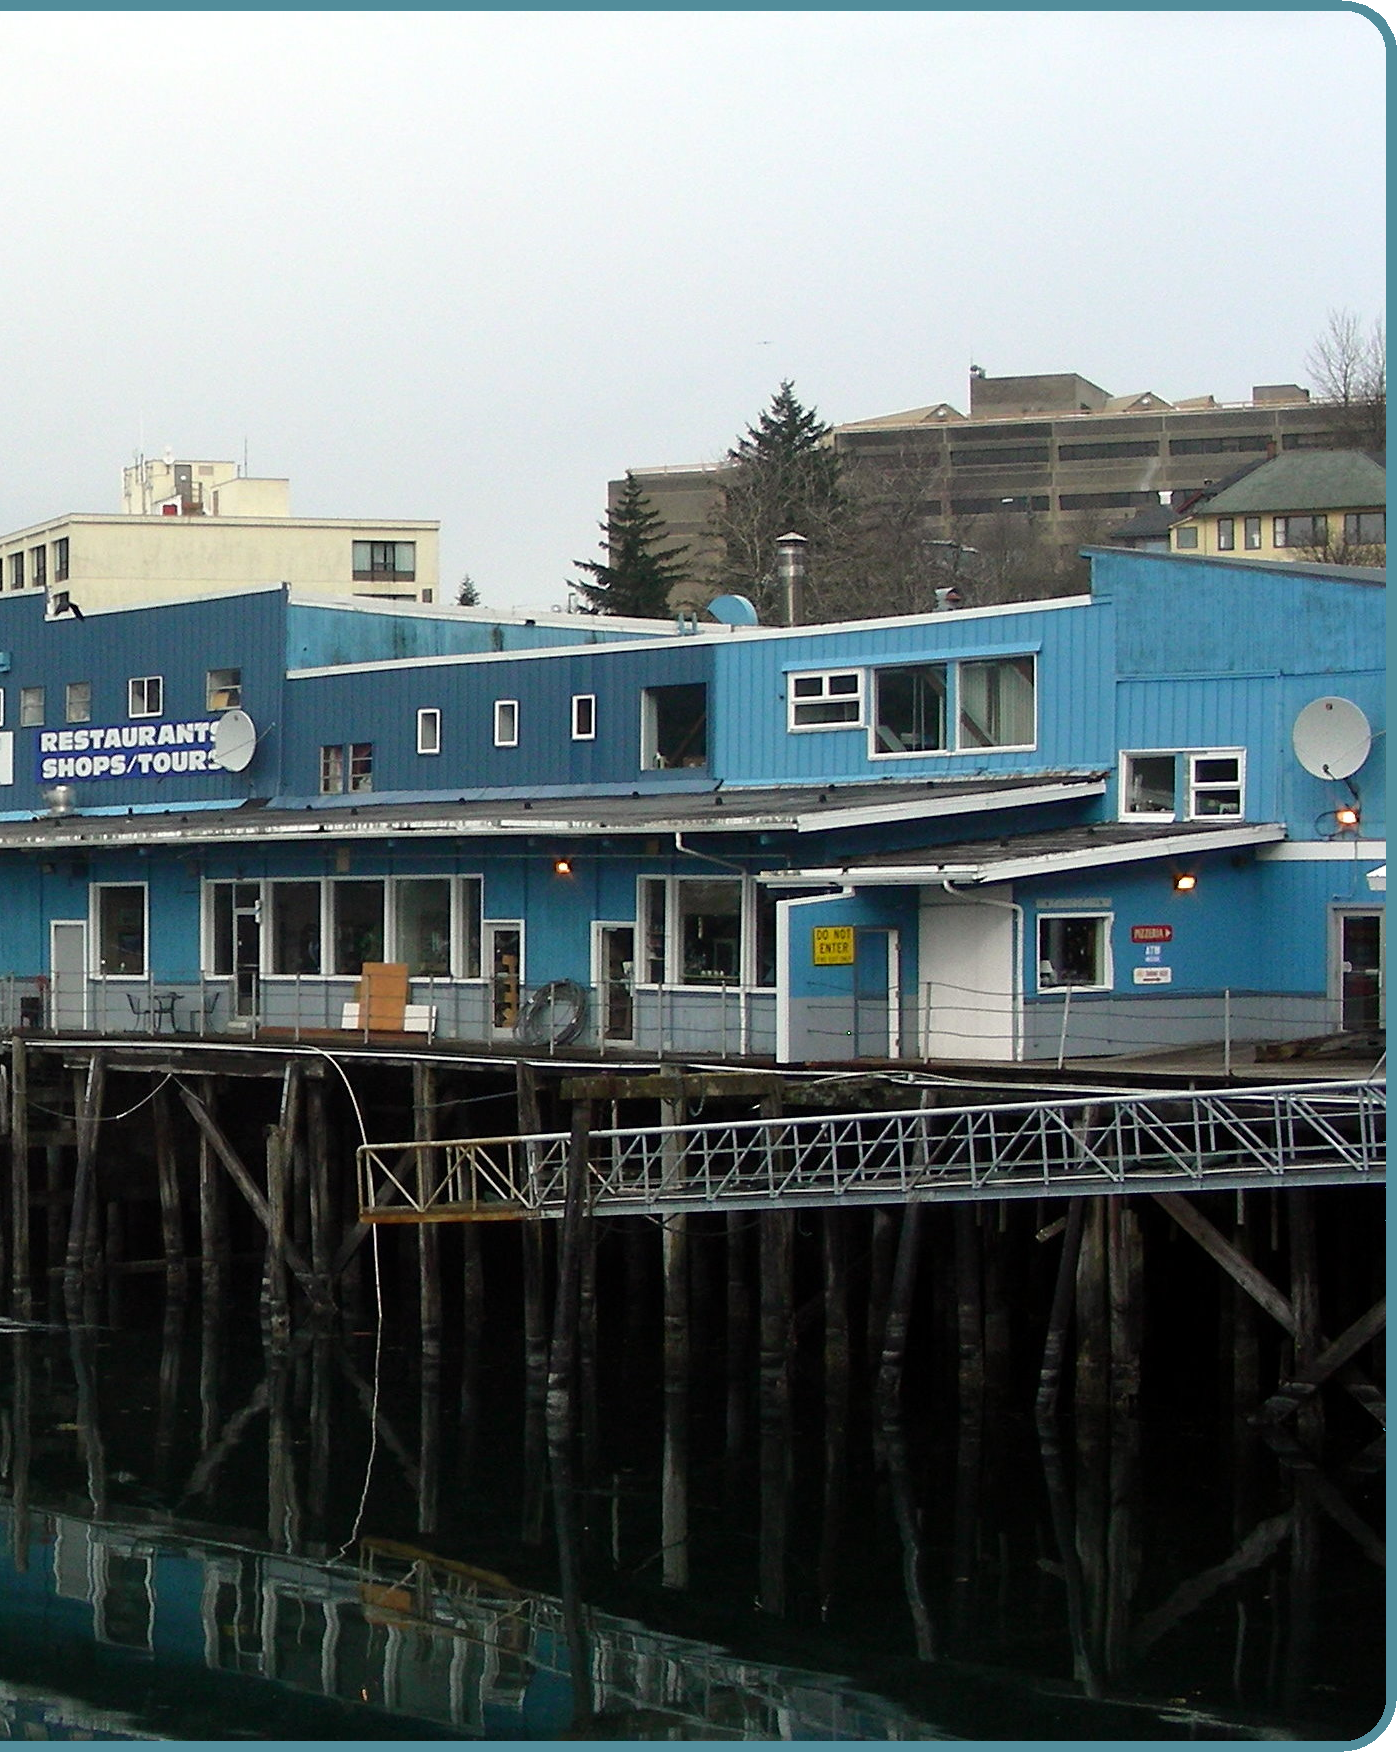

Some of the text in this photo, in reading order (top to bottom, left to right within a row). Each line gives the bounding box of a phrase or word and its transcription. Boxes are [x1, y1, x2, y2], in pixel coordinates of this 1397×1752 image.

[41, 721, 221, 752] RESTAURANTS
[42, 750, 224, 779] SHOPS/TOURS
[817, 928, 851, 940] DO NOT
[1134, 928, 1164, 939] PIZZERIA
[819, 942, 849, 954] ENTER
